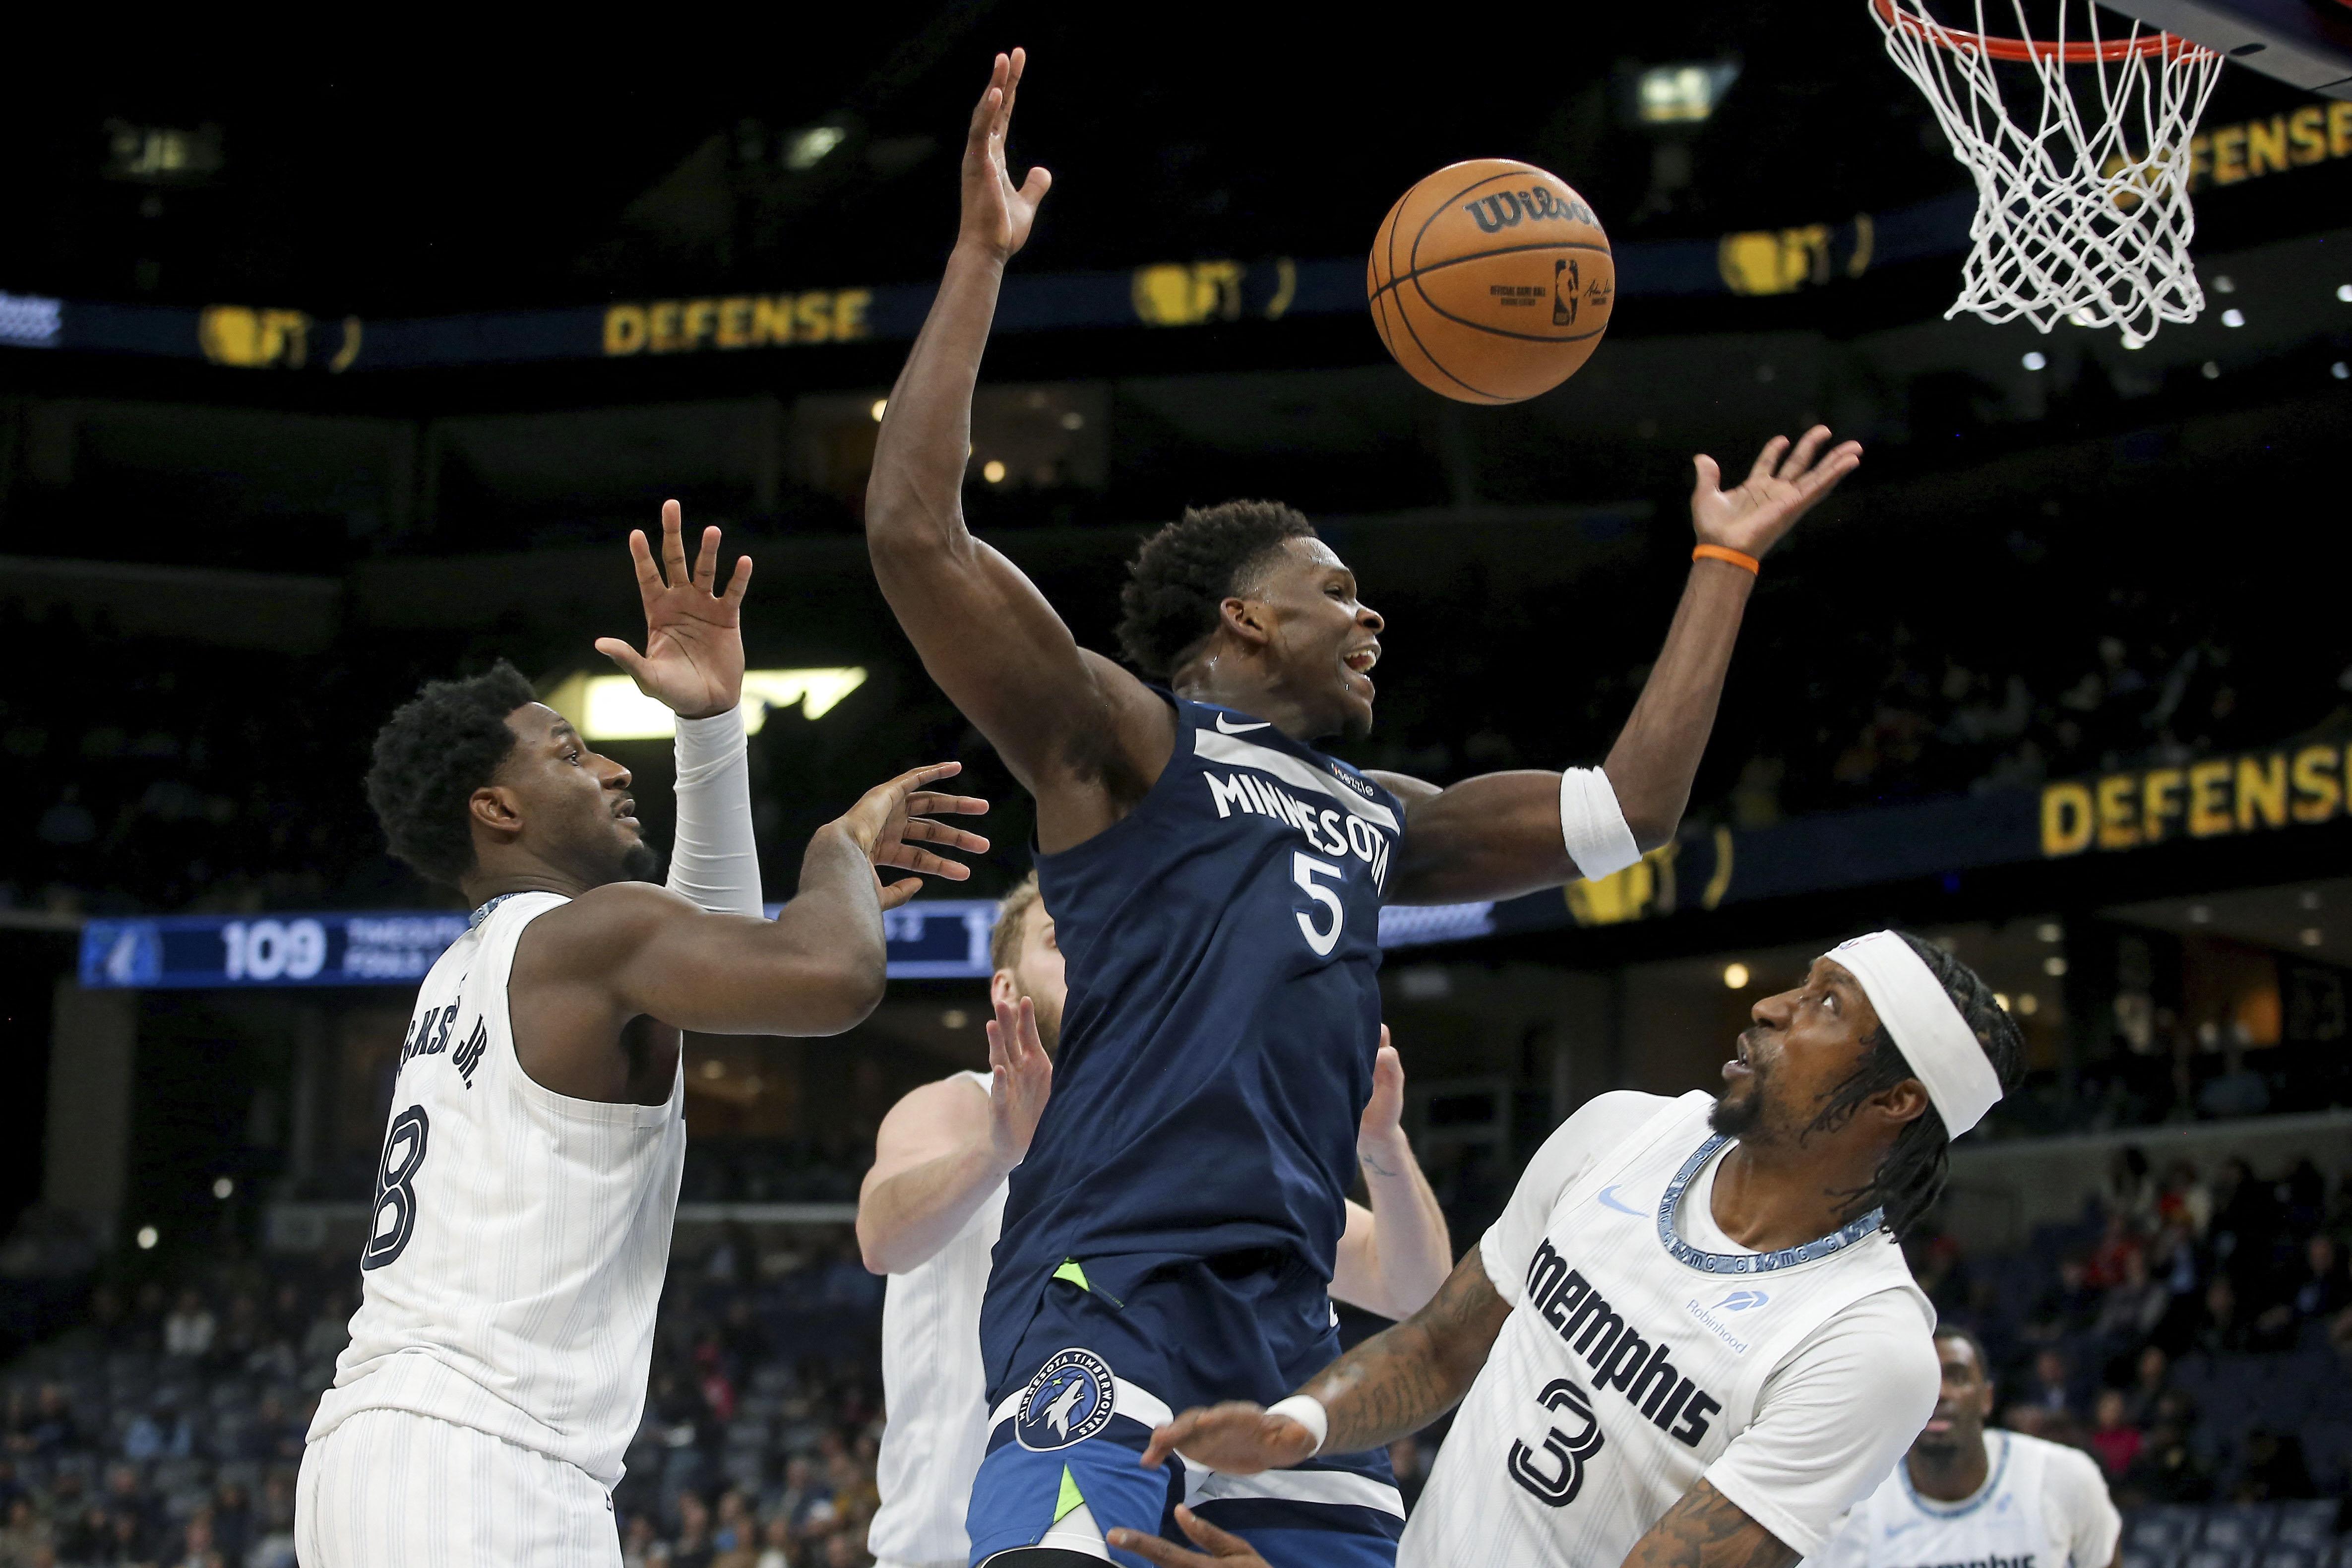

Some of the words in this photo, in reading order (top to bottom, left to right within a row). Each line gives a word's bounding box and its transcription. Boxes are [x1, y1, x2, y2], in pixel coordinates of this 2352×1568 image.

[1463, 187, 1605, 233] Wilso
[603, 288, 871, 356] DEFENSE
[1203, 771, 1389, 898] MINNESOTA
[2040, 744, 2352, 856] DEFENS
[222, 917, 327, 981] 109
[1293, 851, 1344, 956] 5
[362, 1104, 429, 1271] 8
[1527, 1237, 1722, 1448] memphis
[1687, 1299, 1748, 1355] Robinhood
[1018, 1355, 1068, 1422] MINNESOTA
[1073, 1353, 1113, 1436] TIMBERWOLVES
[1507, 1377, 1606, 1507] 3
